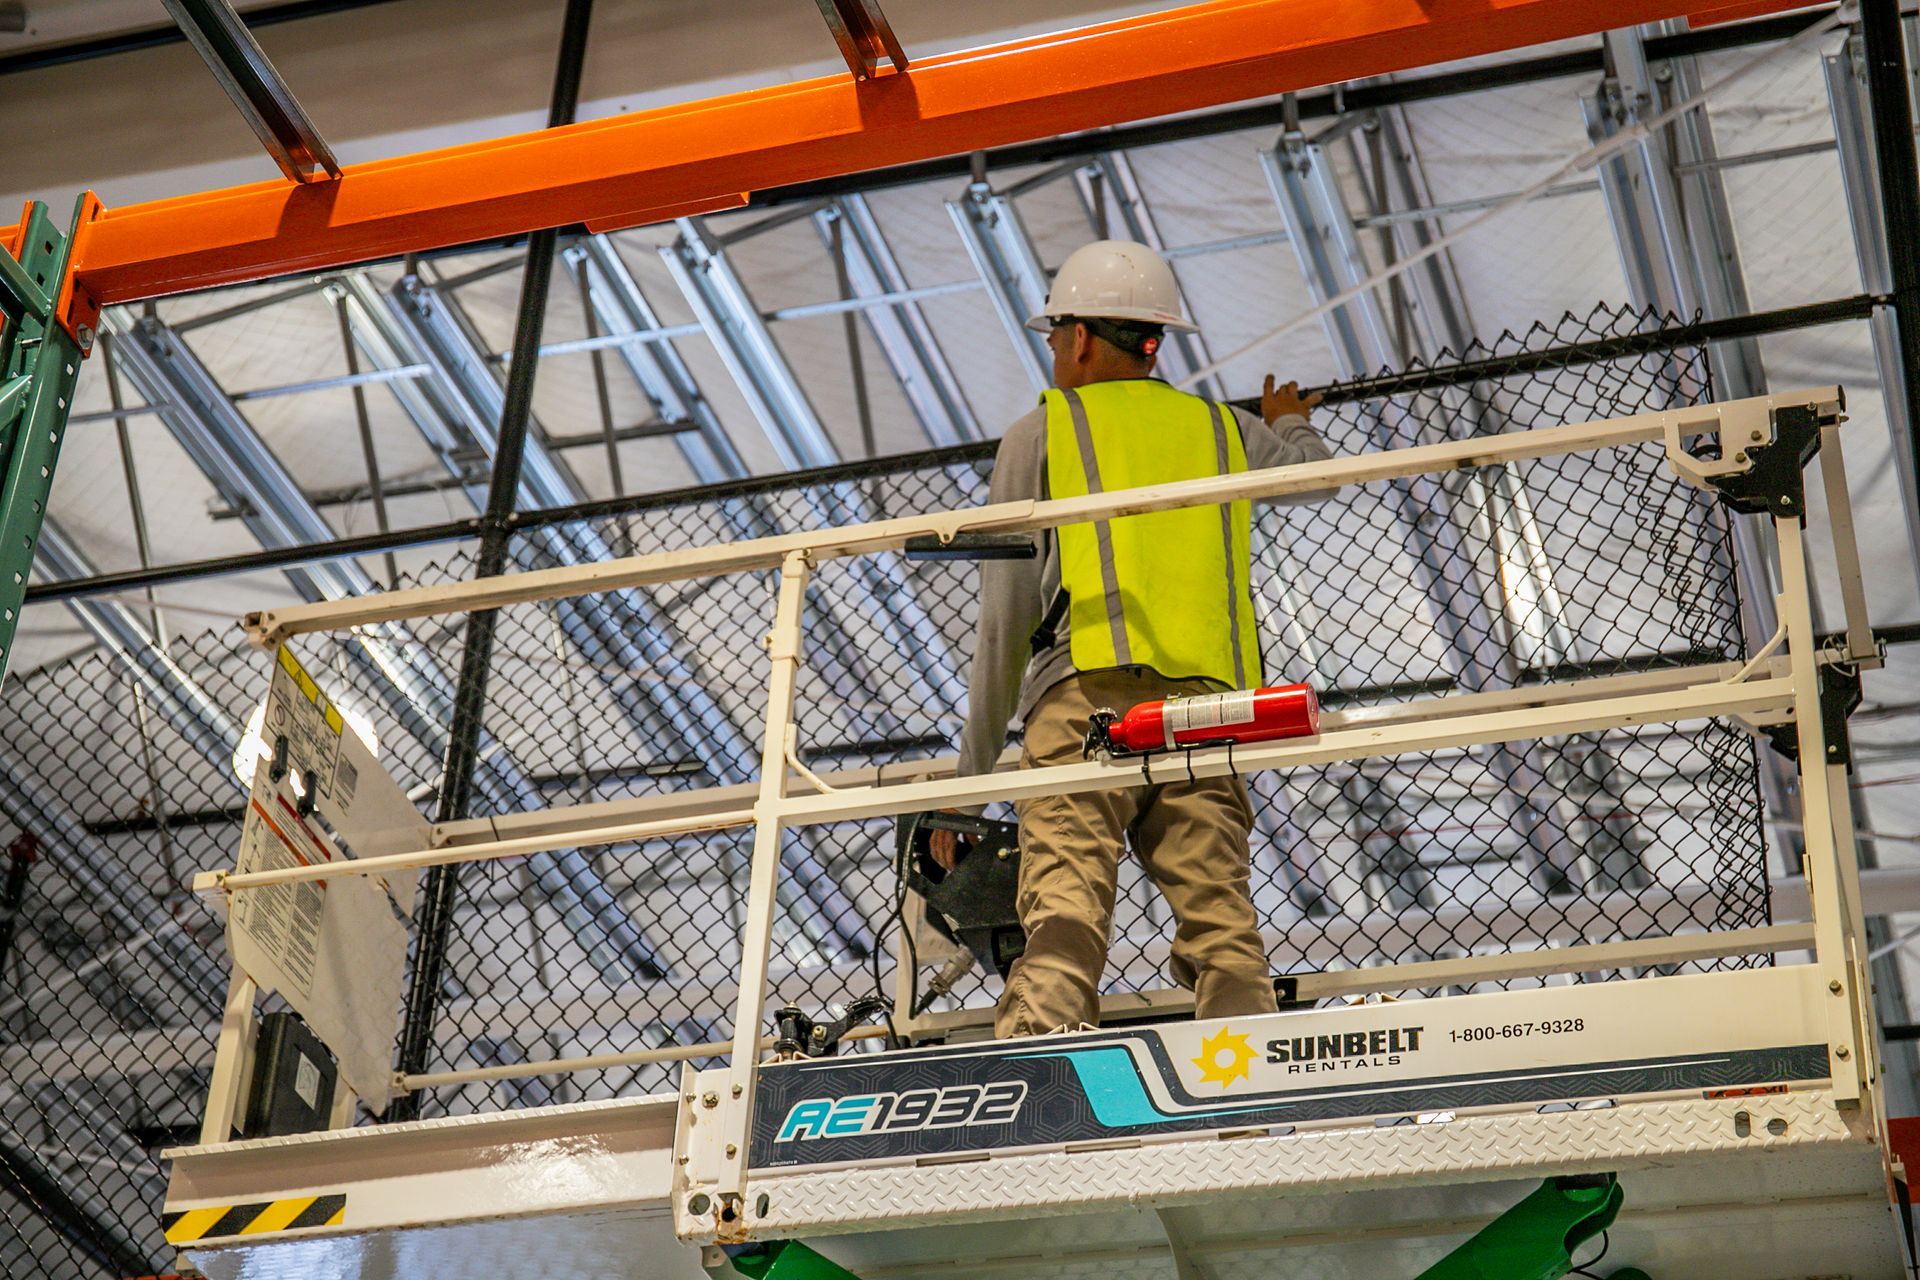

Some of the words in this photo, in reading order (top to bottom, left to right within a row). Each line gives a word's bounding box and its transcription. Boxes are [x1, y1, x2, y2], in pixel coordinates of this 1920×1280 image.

[1266, 1026, 1424, 1064] SUNBELT
[1449, 1018, 1585, 1043] 1-800-667-9328
[1288, 1055, 1401, 1075] RENTALS
[775, 1081, 1028, 1143] AE1932
